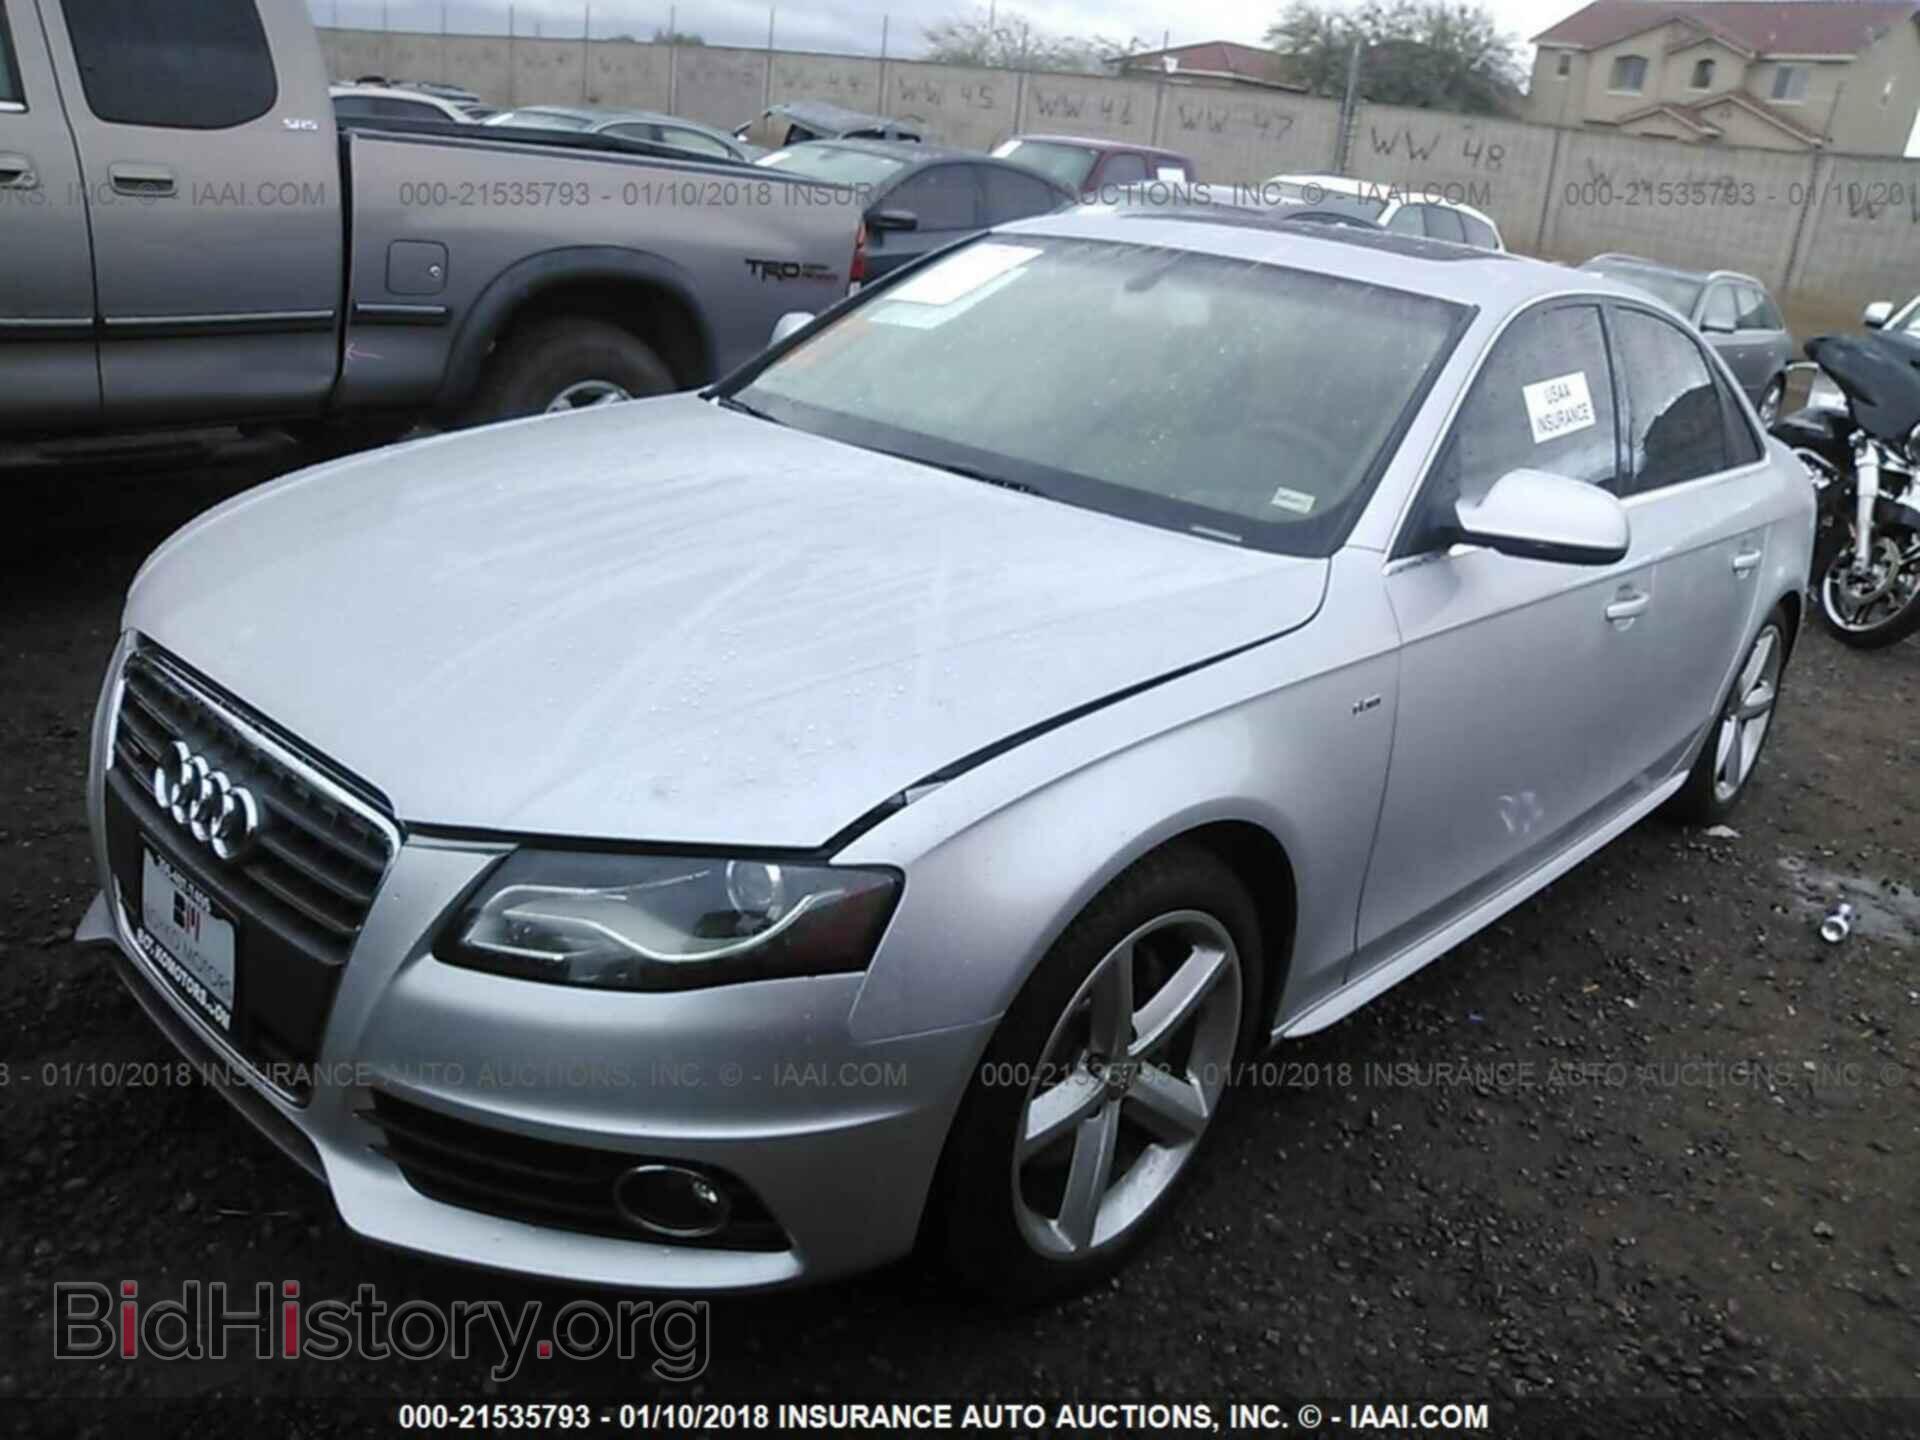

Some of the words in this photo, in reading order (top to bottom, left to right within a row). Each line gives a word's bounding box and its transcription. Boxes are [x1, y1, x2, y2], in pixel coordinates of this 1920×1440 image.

[1178, 103, 1232, 134] WW
[1370, 126, 1442, 162] WW
[1460, 134, 1506, 171] 48
[744, 258, 800, 282] TRD
[1537, 402, 1591, 433] INSURANCE
